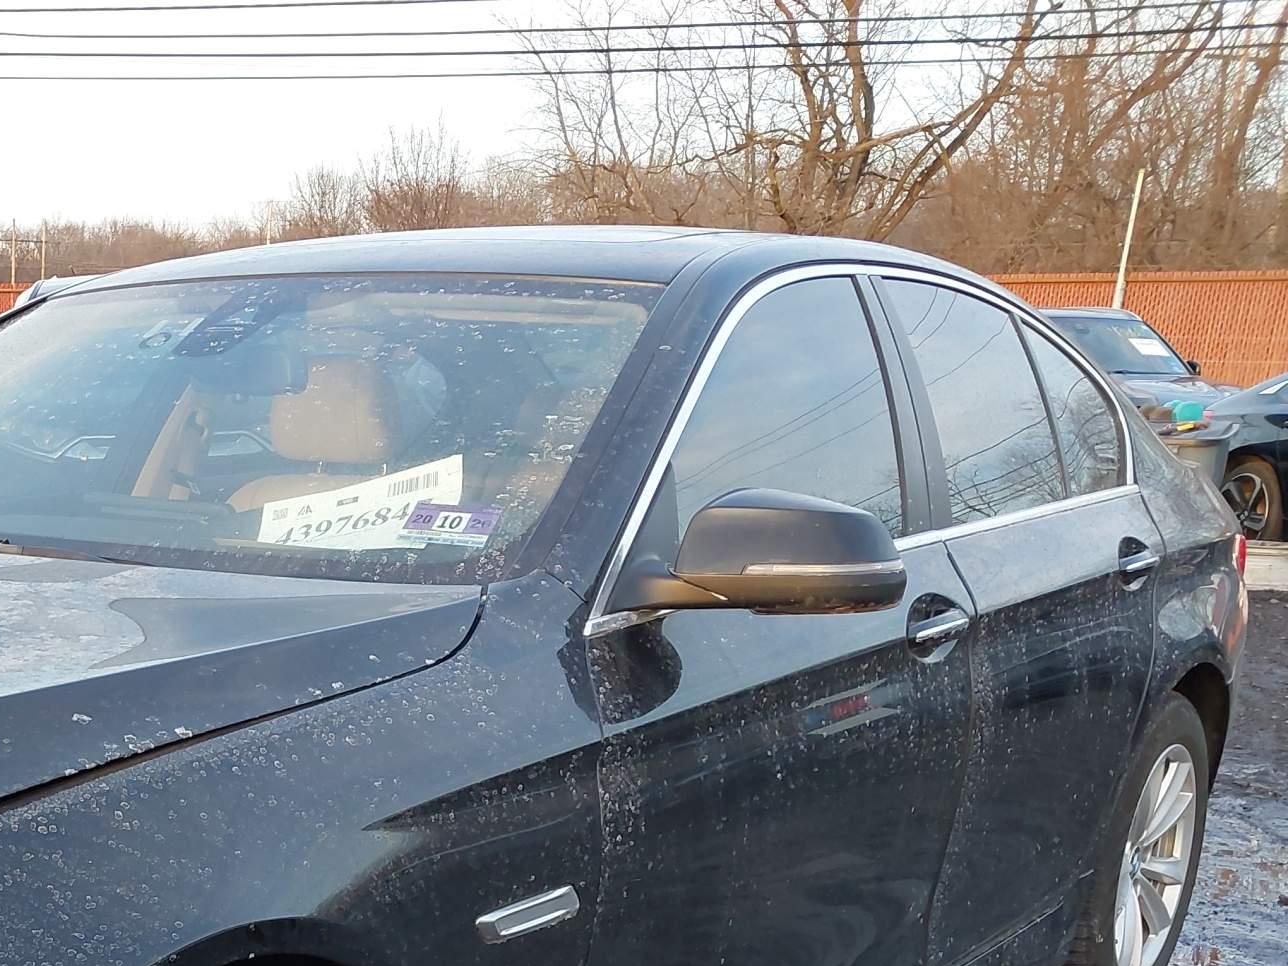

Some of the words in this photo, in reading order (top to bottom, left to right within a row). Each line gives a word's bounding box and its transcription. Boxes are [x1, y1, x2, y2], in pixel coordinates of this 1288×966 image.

[275, 500, 431, 545] 4397684
[412, 513, 432, 524] 20
[437, 515, 462, 530] 10
